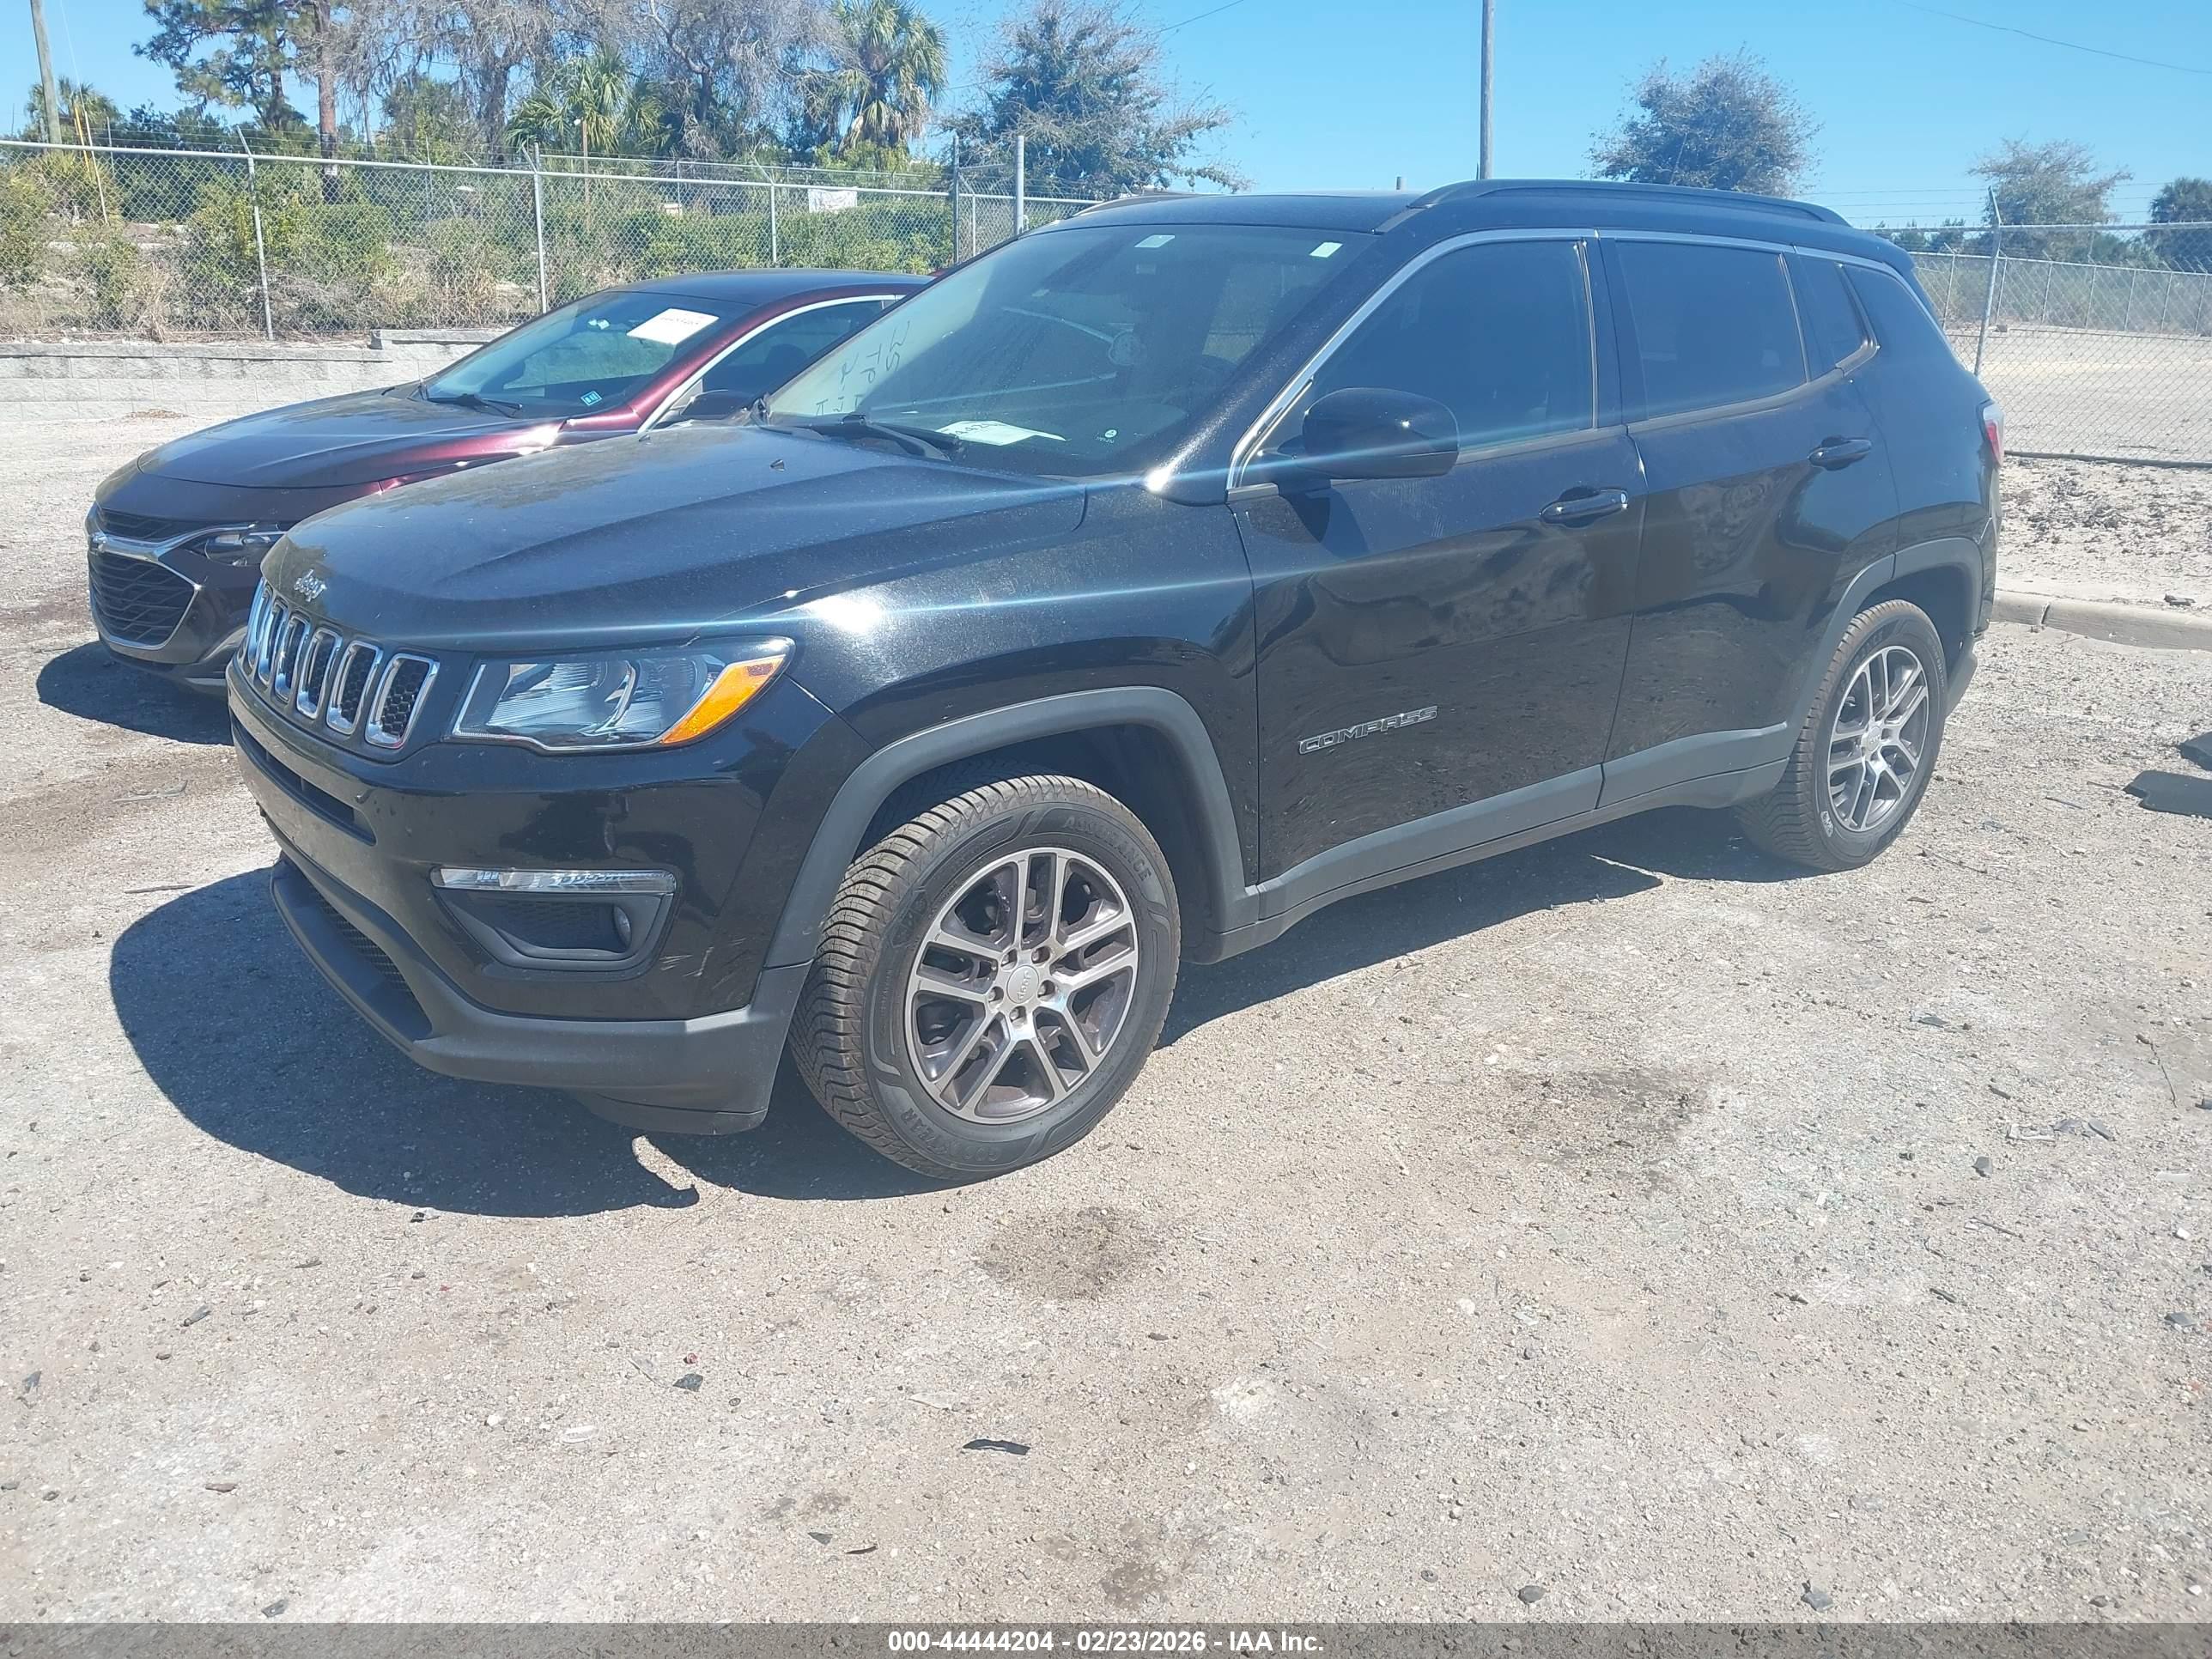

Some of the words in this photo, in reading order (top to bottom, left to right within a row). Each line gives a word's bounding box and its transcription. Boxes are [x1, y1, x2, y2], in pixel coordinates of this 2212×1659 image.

[294, 568, 327, 602] Jeep
[1297, 705, 1438, 755] COMPASS
[1017, 969, 1031, 1000] Jeep
